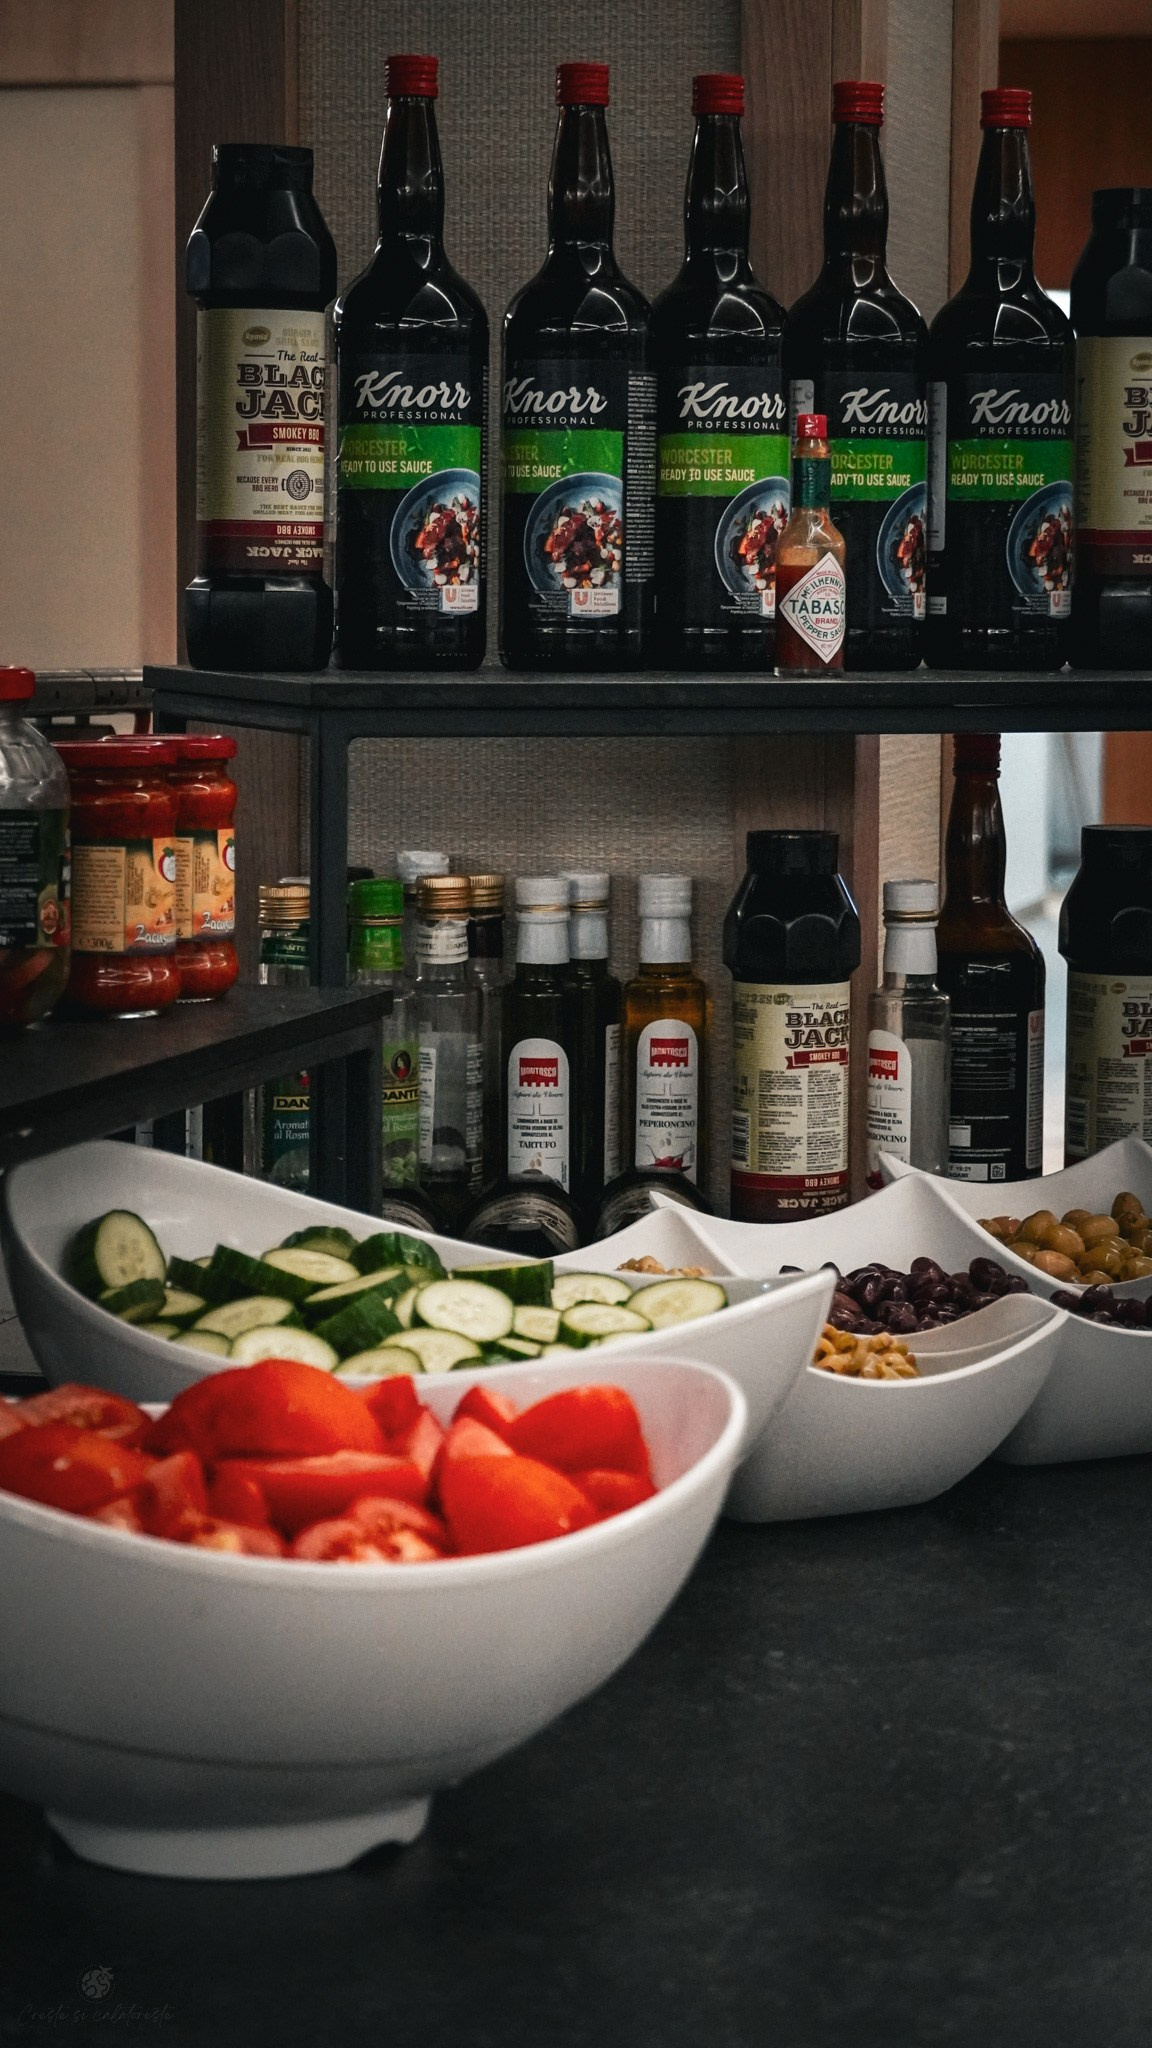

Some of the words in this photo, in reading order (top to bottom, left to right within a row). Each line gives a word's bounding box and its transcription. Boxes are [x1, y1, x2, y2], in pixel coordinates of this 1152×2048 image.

[277, 350, 296, 361] The
[300, 351, 319, 362] Real
[354, 370, 471, 409] Knorr
[503, 377, 608, 414] Knorr
[677, 382, 787, 419] Knorr
[969, 388, 1072, 425] Knorr
[363, 411, 463, 420] PROFESSIONAL
[506, 416, 596, 425] PROFESSIONAL
[687, 421, 780, 430] PROFESSIONAL
[980, 426, 1067, 436] PROFESSIONAL
[272, 427, 306, 440] SMOKEY
[308, 428, 320, 440] BBQ
[660, 449, 732, 465] WORCESTER
[951, 454, 1024, 470] WORCESTER
[365, 461, 377, 473] TO
[378, 461, 398, 473] USE
[399, 461, 433, 474] SAUCE
[516, 465, 531, 478] USE
[532, 465, 562, 478] SAUCE
[236, 475, 260, 484] BECAUSE
[261, 476, 279, 485] EVERY
[660, 468, 687, 481] READY
[689, 468, 701, 481] TO
[704, 469, 723, 481] USE
[725, 469, 755, 481] SAUCE
[852, 474, 865, 486] TO
[866, 474, 884, 487] USE
[886, 475, 911, 487] SAUCE
[951, 474, 979, 486] READY
[981, 474, 994, 486] TO
[996, 474, 1014, 486] USE
[1016, 474, 1045, 486] SAUCE
[264, 484, 279, 493] HERO
[276, 525, 291, 535] BBQ
[292, 525, 316, 536] SMOKEY
[246, 546, 292, 558] JACK
[800, 614, 829, 639] PEPPER
[815, 617, 838, 625] BRAND
[812, 1002, 824, 1010] The
[825, 1002, 839, 1010] Real
[785, 1008, 849, 1028] BLACK
[784, 1025, 849, 1049] JACK
[808, 1051, 831, 1061] SMOKEY
[639, 1119, 696, 1129] PEPERONCINO
[273, 1129, 283, 1140] al
[518, 1140, 557, 1149] TARTUFO
[777, 1198, 818, 1208] JACK
